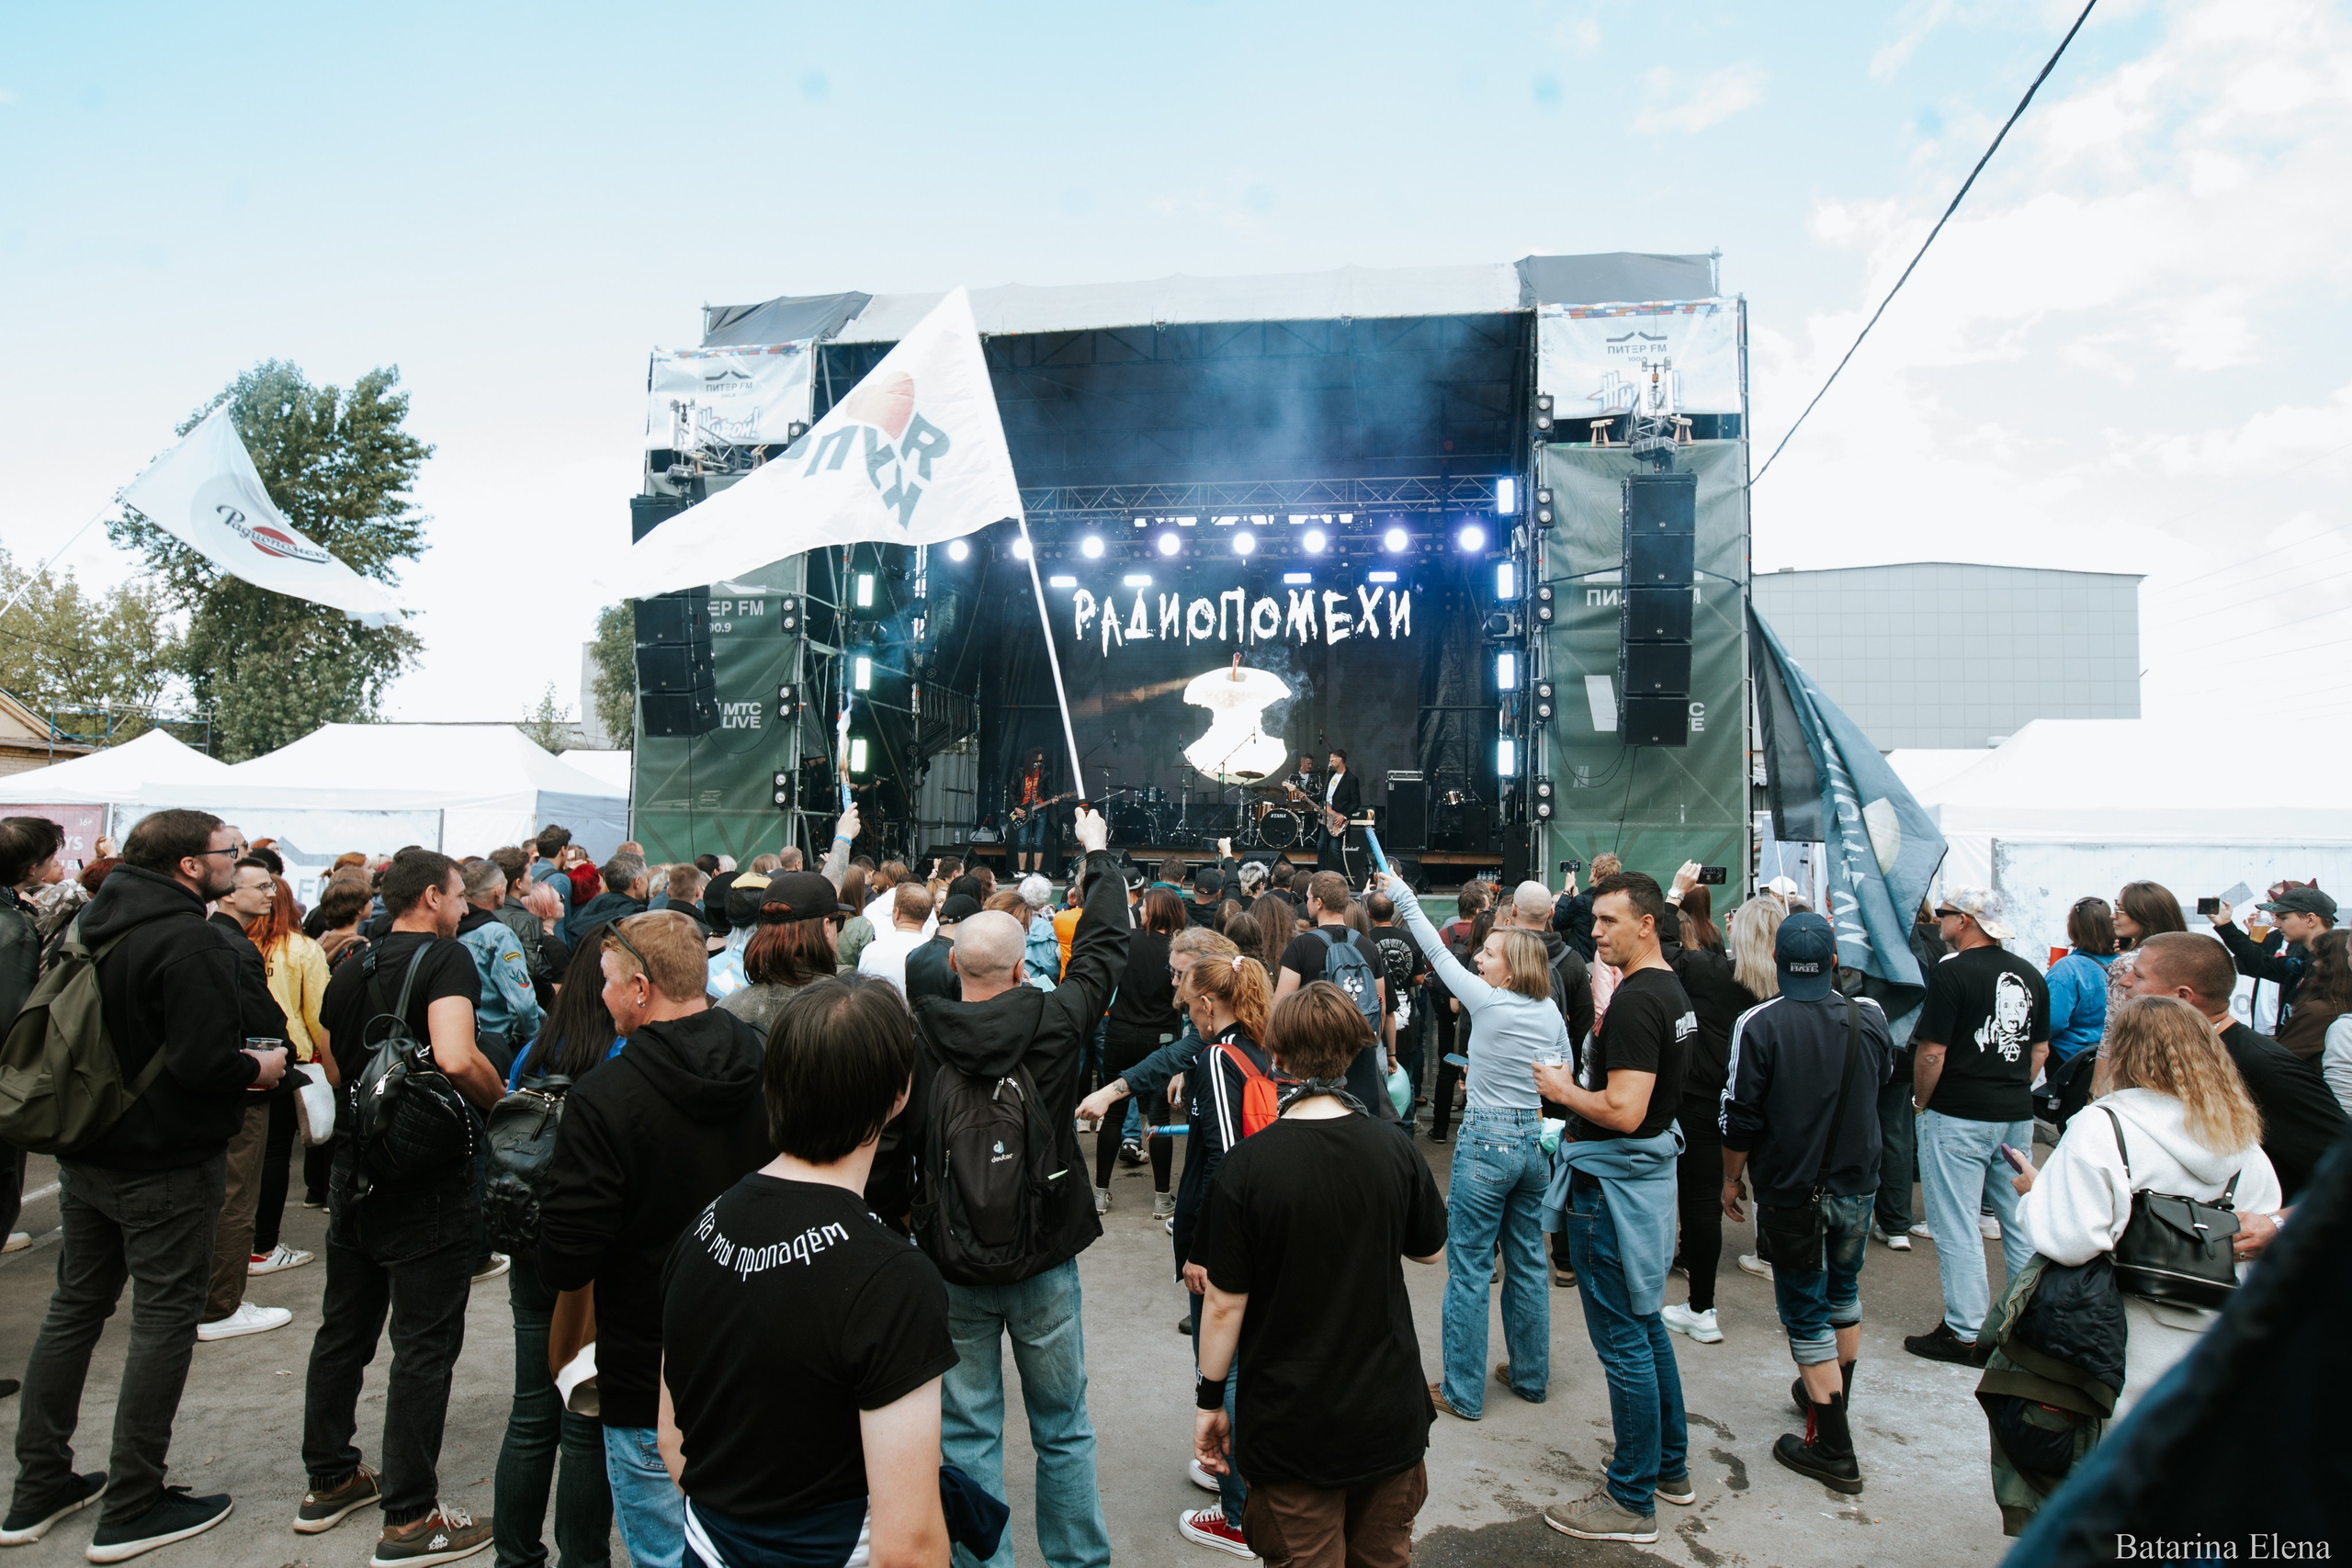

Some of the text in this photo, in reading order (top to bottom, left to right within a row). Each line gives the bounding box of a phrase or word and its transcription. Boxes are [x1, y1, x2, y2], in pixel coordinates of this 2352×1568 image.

[1650, 344, 1668, 353] FM
[740, 381, 753, 390] FM
[738, 600, 764, 616] FM
[1073, 585, 1411, 658] РАДИОПОМЕХИ
[722, 716, 762, 728] LIVE
[79, 818, 93, 827] 16+
[991, 1153, 1013, 1163] deuter
[707, 1232, 735, 1267] мы
[734, 1222, 850, 1282] пропадём
